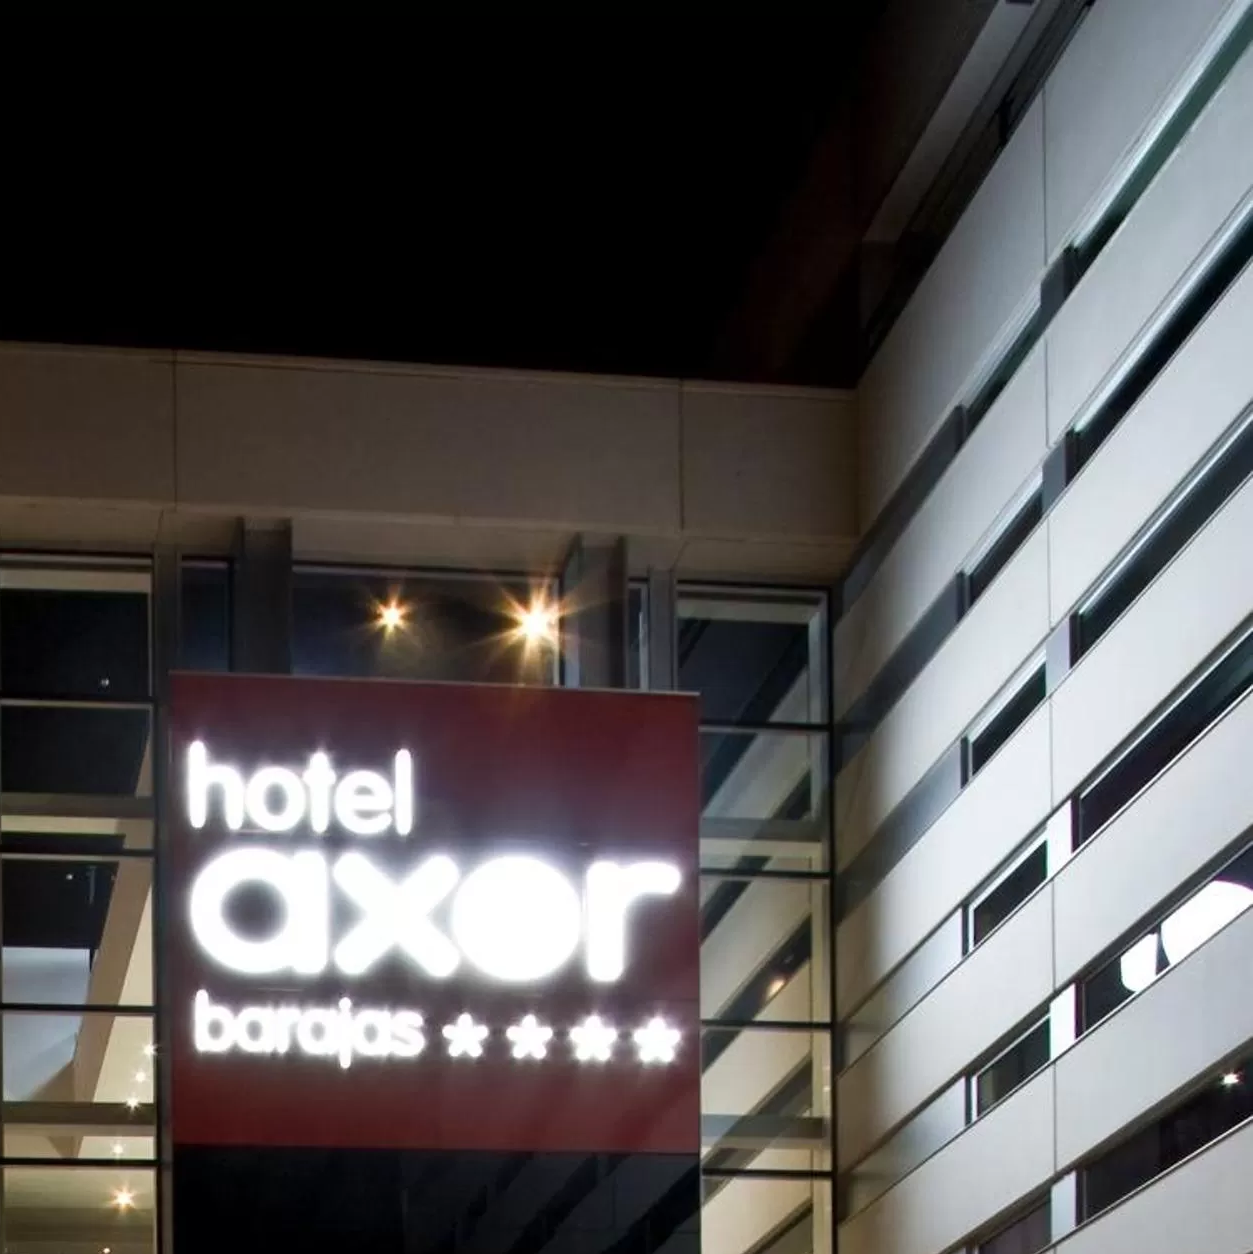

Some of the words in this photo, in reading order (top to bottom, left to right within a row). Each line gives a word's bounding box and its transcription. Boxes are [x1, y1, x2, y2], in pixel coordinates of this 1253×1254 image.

[185, 739, 415, 838] hotel
[189, 845, 684, 984] axor
[193, 988, 428, 1069] barajas
